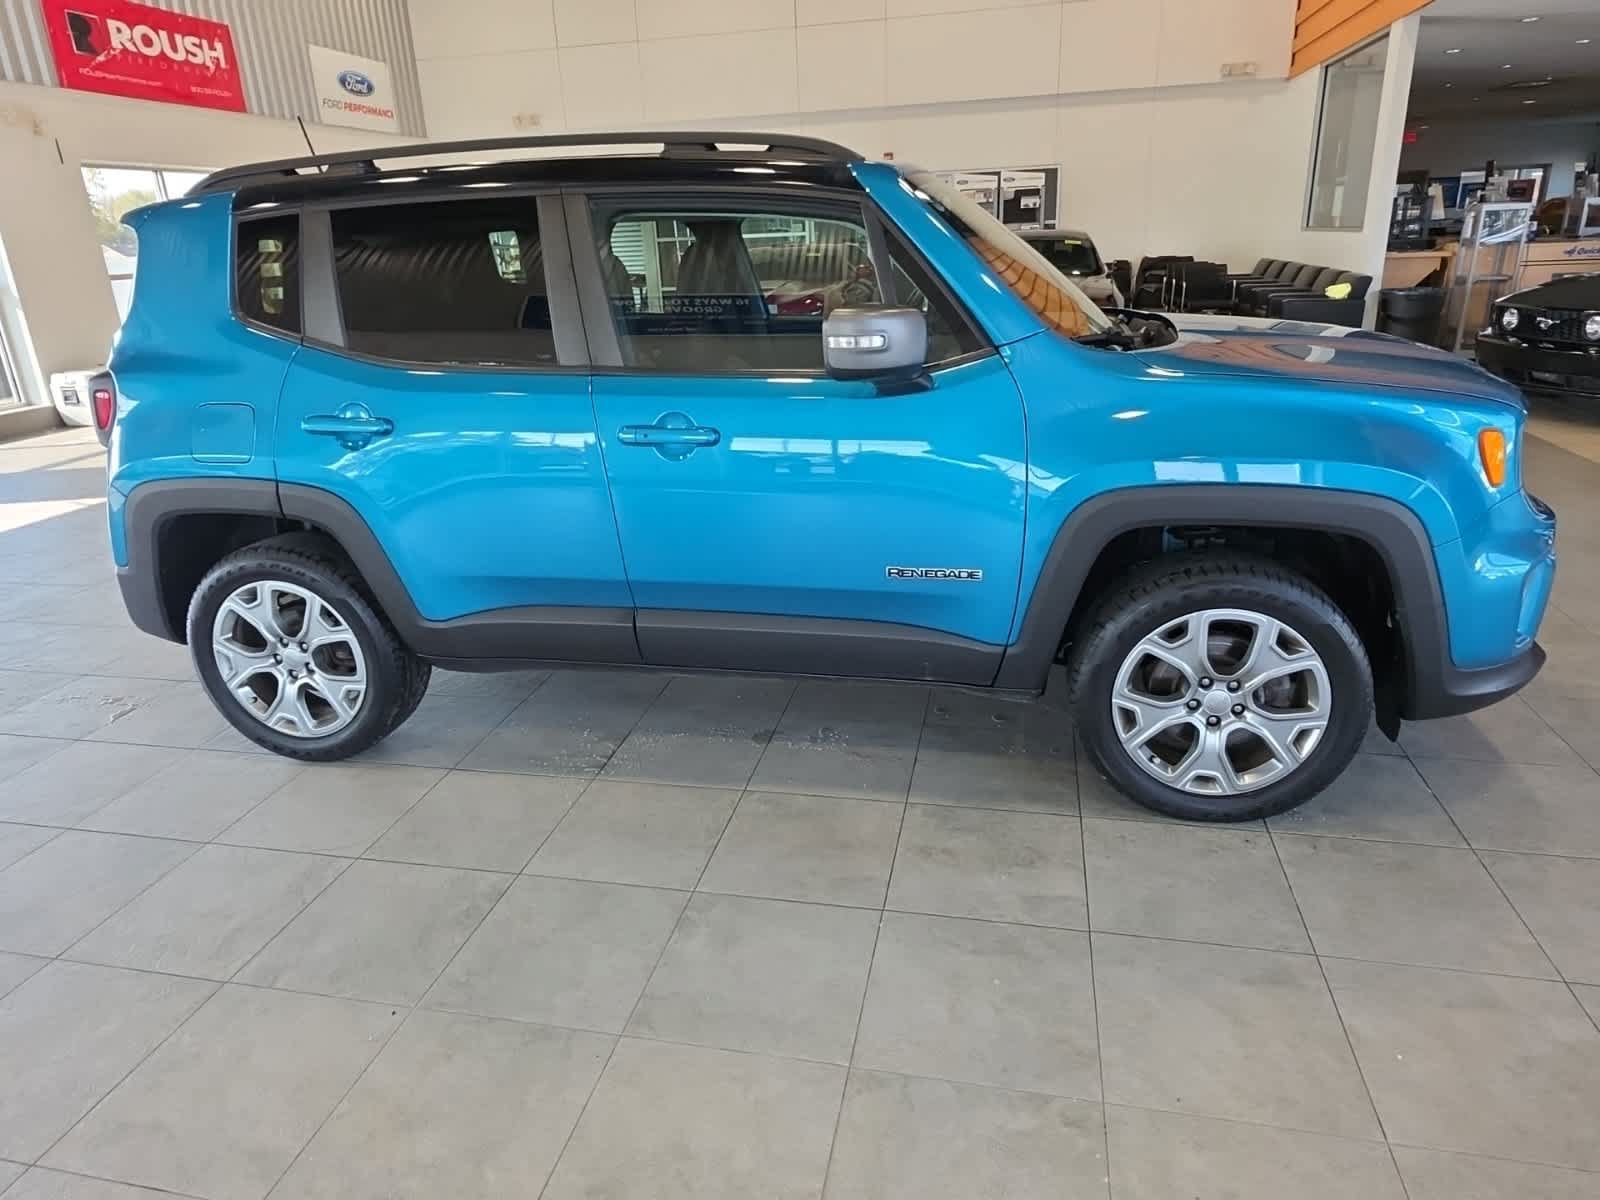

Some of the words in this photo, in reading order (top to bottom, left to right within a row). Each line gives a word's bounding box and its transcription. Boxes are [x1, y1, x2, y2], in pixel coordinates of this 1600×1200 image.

[106, 19, 227, 69] ROUSH
[322, 97, 343, 111] FORD
[343, 101, 394, 119] PERFORMANCE
[886, 566, 983, 581] RENEGADE
